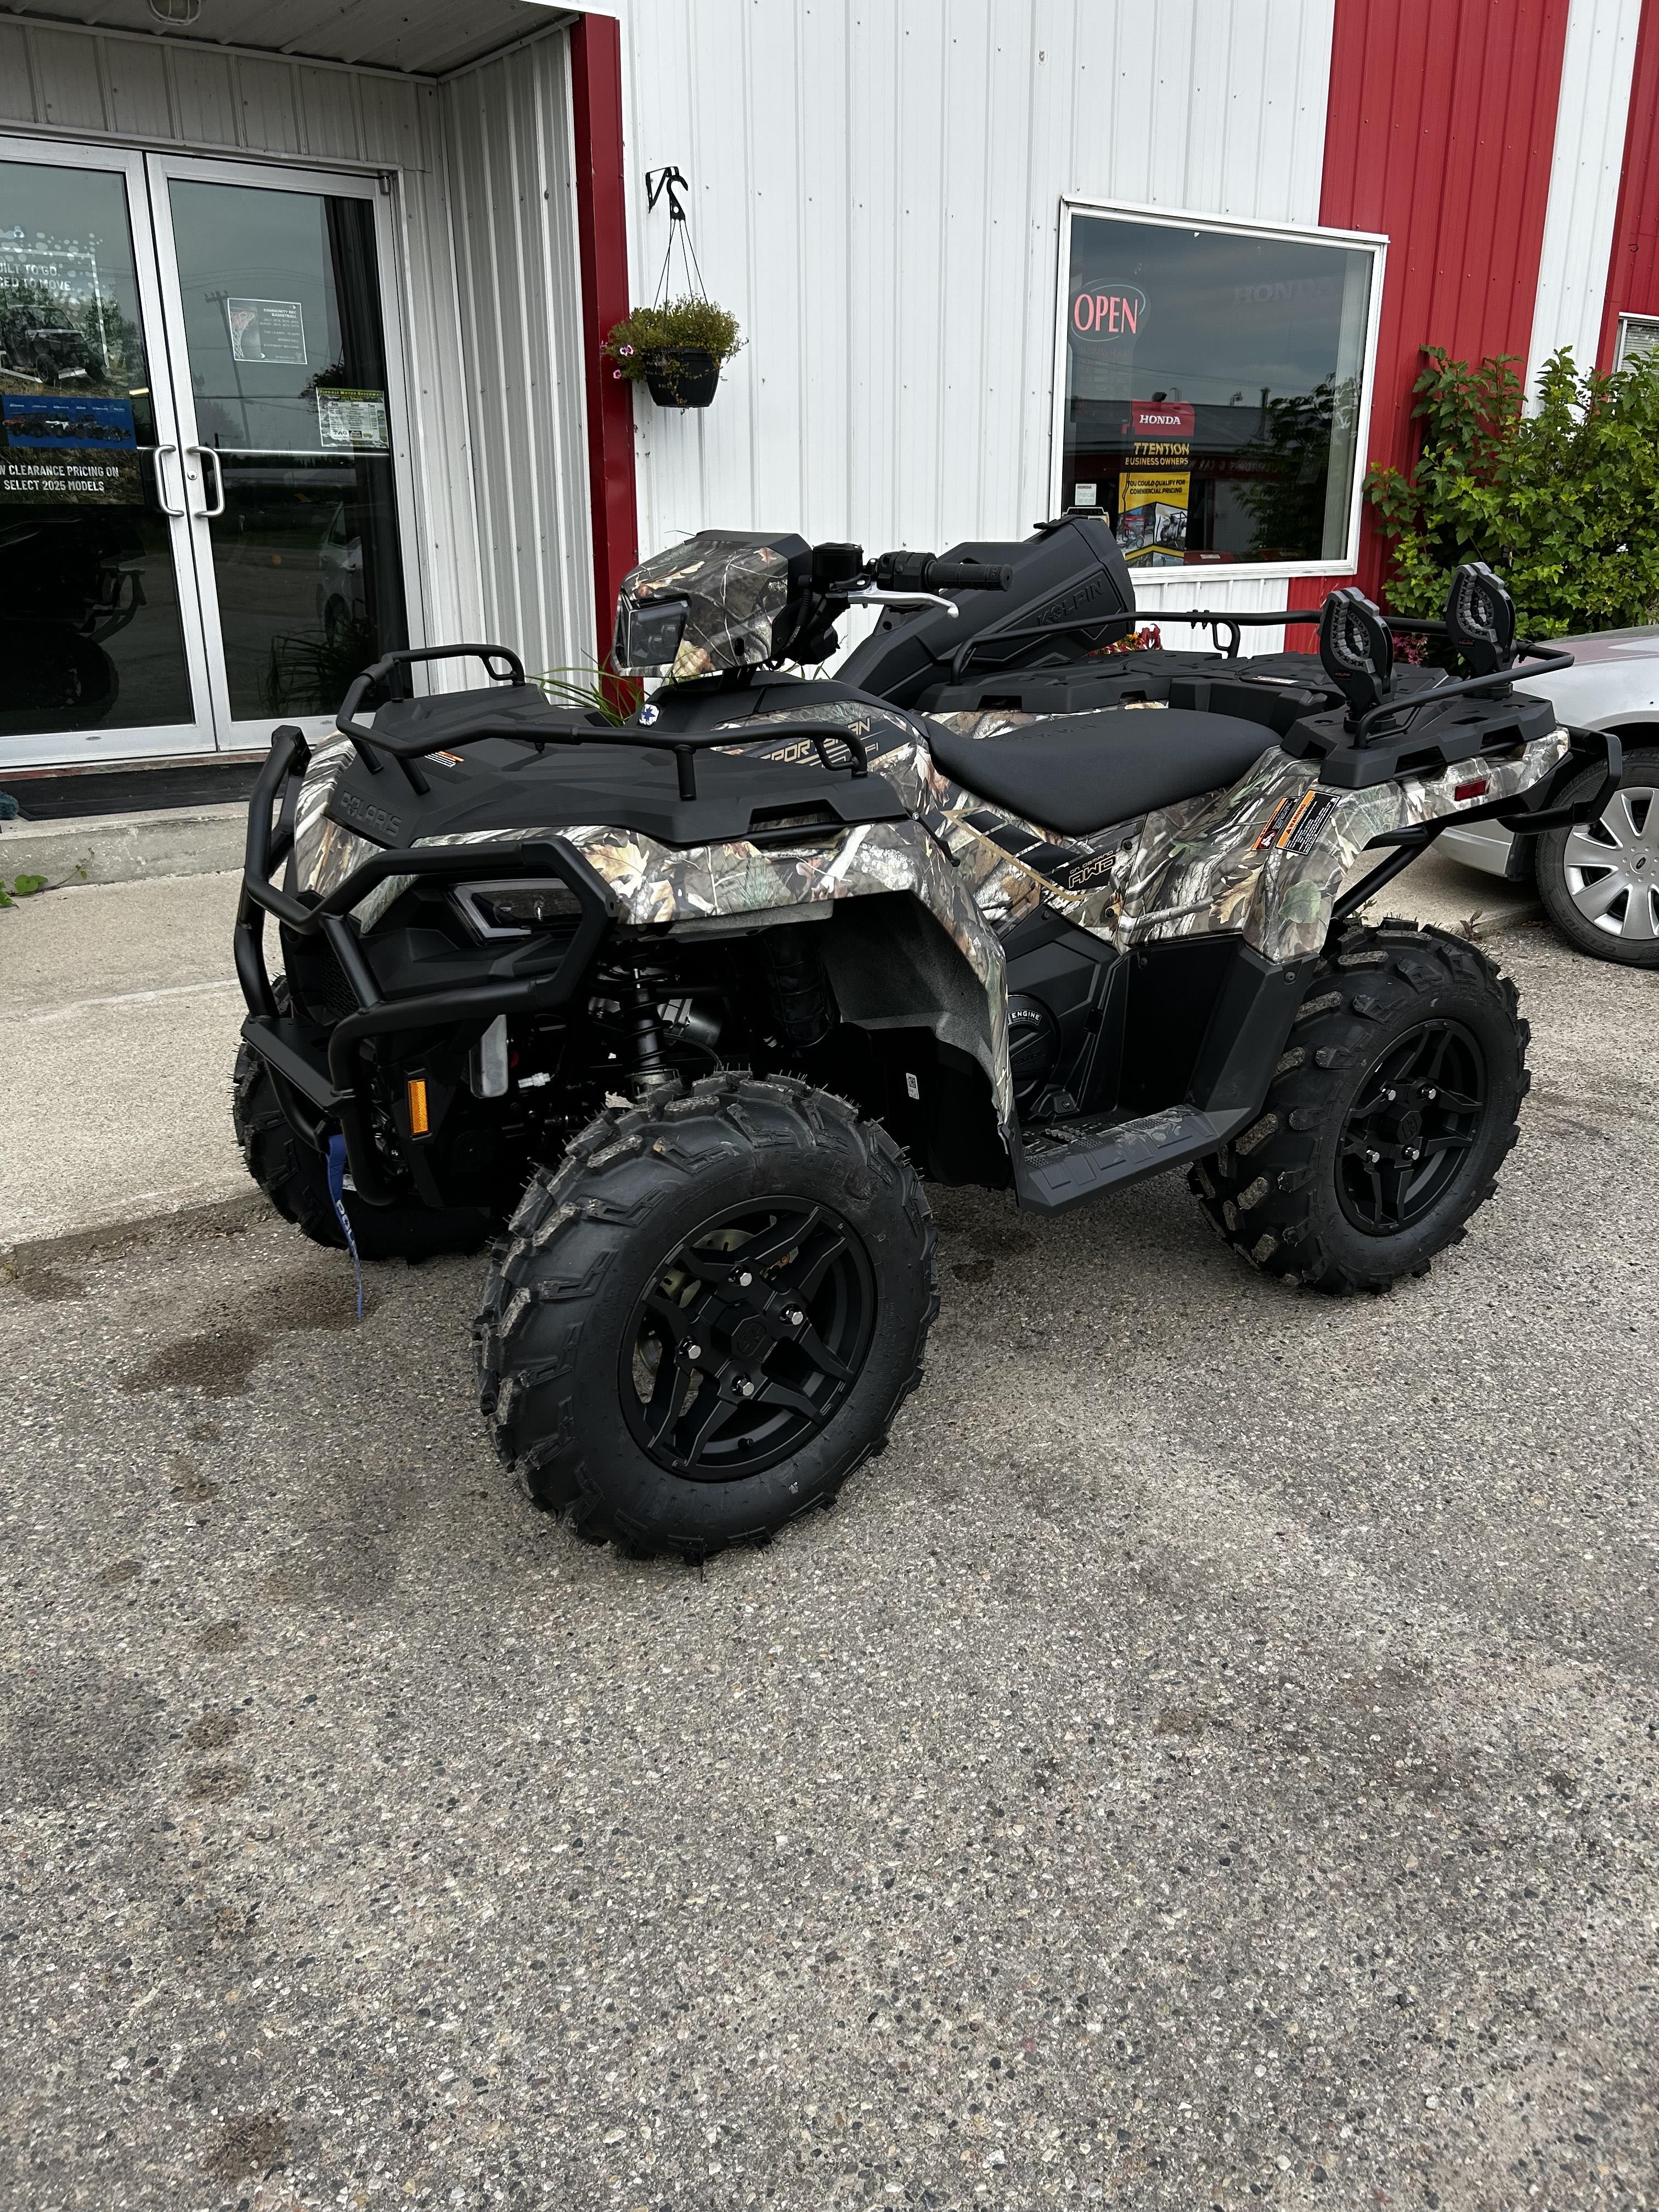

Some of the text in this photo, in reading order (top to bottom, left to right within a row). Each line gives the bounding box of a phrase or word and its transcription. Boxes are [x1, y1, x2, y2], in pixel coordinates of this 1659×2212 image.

[23, 264, 39, 274] TO
[41, 266, 61, 276] GO.
[22, 278, 37, 288] TO
[1074, 294, 1138, 334] OPEN
[1139, 415, 1181, 425] HONDA
[1133, 442, 1190, 455] TTENTION
[1160, 457, 1188, 465] OWNERS
[9, 465, 65, 476] CLEARANCE
[66, 466, 104, 477] PRICING
[106, 466, 119, 477] ON
[3, 479, 105, 492] SELECT 2025 MODELS
[341, 791, 402, 837] POLARIS
[1068, 854, 1116, 889] AWD
[1011, 1011, 1040, 1020] ENGINE
